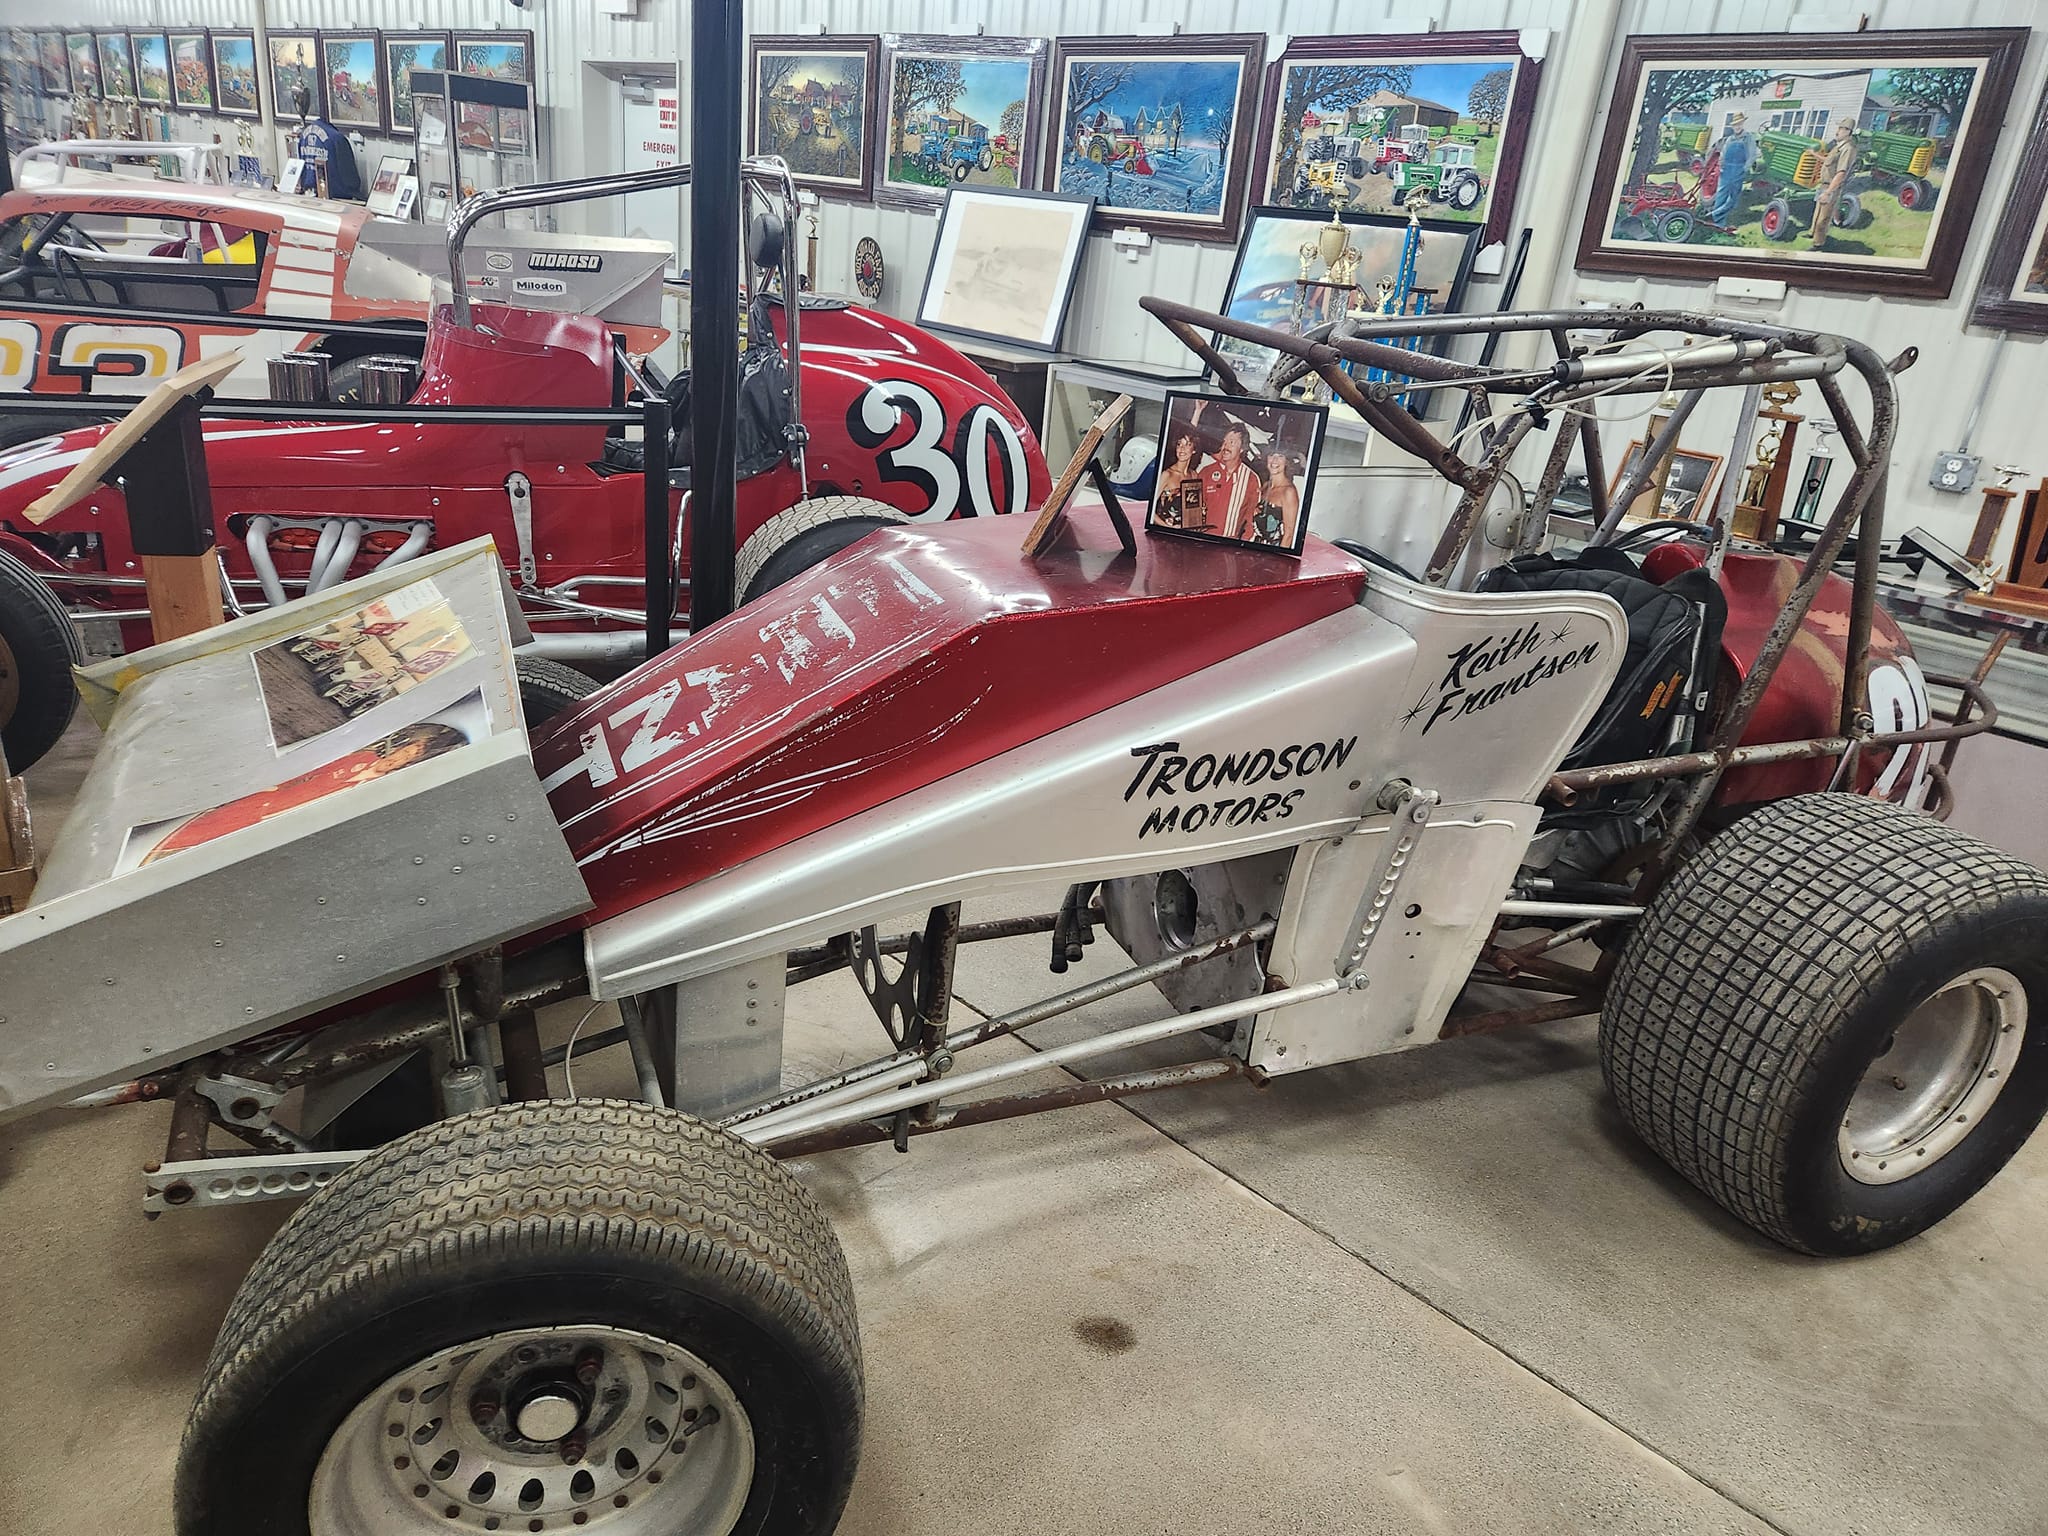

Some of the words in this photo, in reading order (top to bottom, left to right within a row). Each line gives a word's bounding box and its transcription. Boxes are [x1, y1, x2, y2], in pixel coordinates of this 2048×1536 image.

[660, 111, 670, 121] EXIT
[643, 141, 676, 154] EMERGEN
[529, 253, 602, 272] MOROSO
[874, 251, 882, 279] FAIR
[516, 281, 563, 291] Milodon
[848, 378, 1029, 522] 30
[1439, 621, 1546, 692] Keith
[1421, 641, 1600, 736] Frantsen
[1124, 736, 1358, 802] TRONDSON
[1138, 789, 1305, 840] MOTORS
